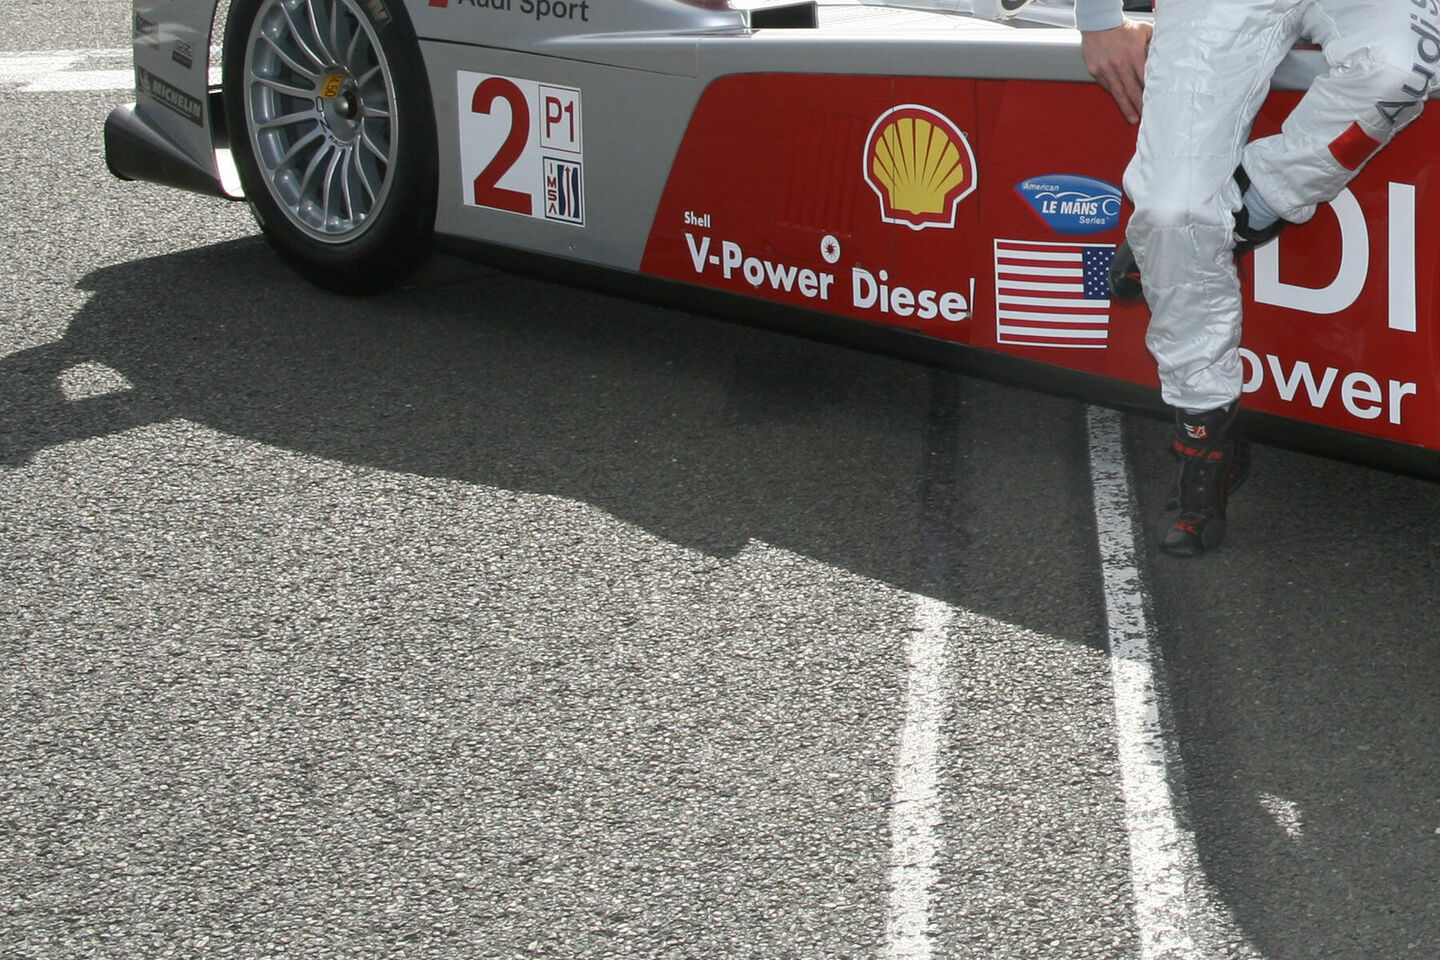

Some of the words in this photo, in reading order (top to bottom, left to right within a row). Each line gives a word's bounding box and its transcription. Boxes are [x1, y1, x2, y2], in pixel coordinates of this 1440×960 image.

[151, 80, 202, 120] MICHELIN
[545, 95, 575, 143] P1
[472, 77, 533, 216] 2
[546, 162, 558, 215] IMSA
[1022, 182, 1059, 192] American
[1042, 200, 1057, 214] LE
[1060, 200, 1098, 216] MANS
[684, 211, 711, 228] Shell
[1079, 216, 1106, 225] Series
[685, 232, 834, 300] V-Power
[852, 266, 975, 321] Diesel
[1253, 180, 1417, 333] DI
[1238, 347, 1417, 425] ower
